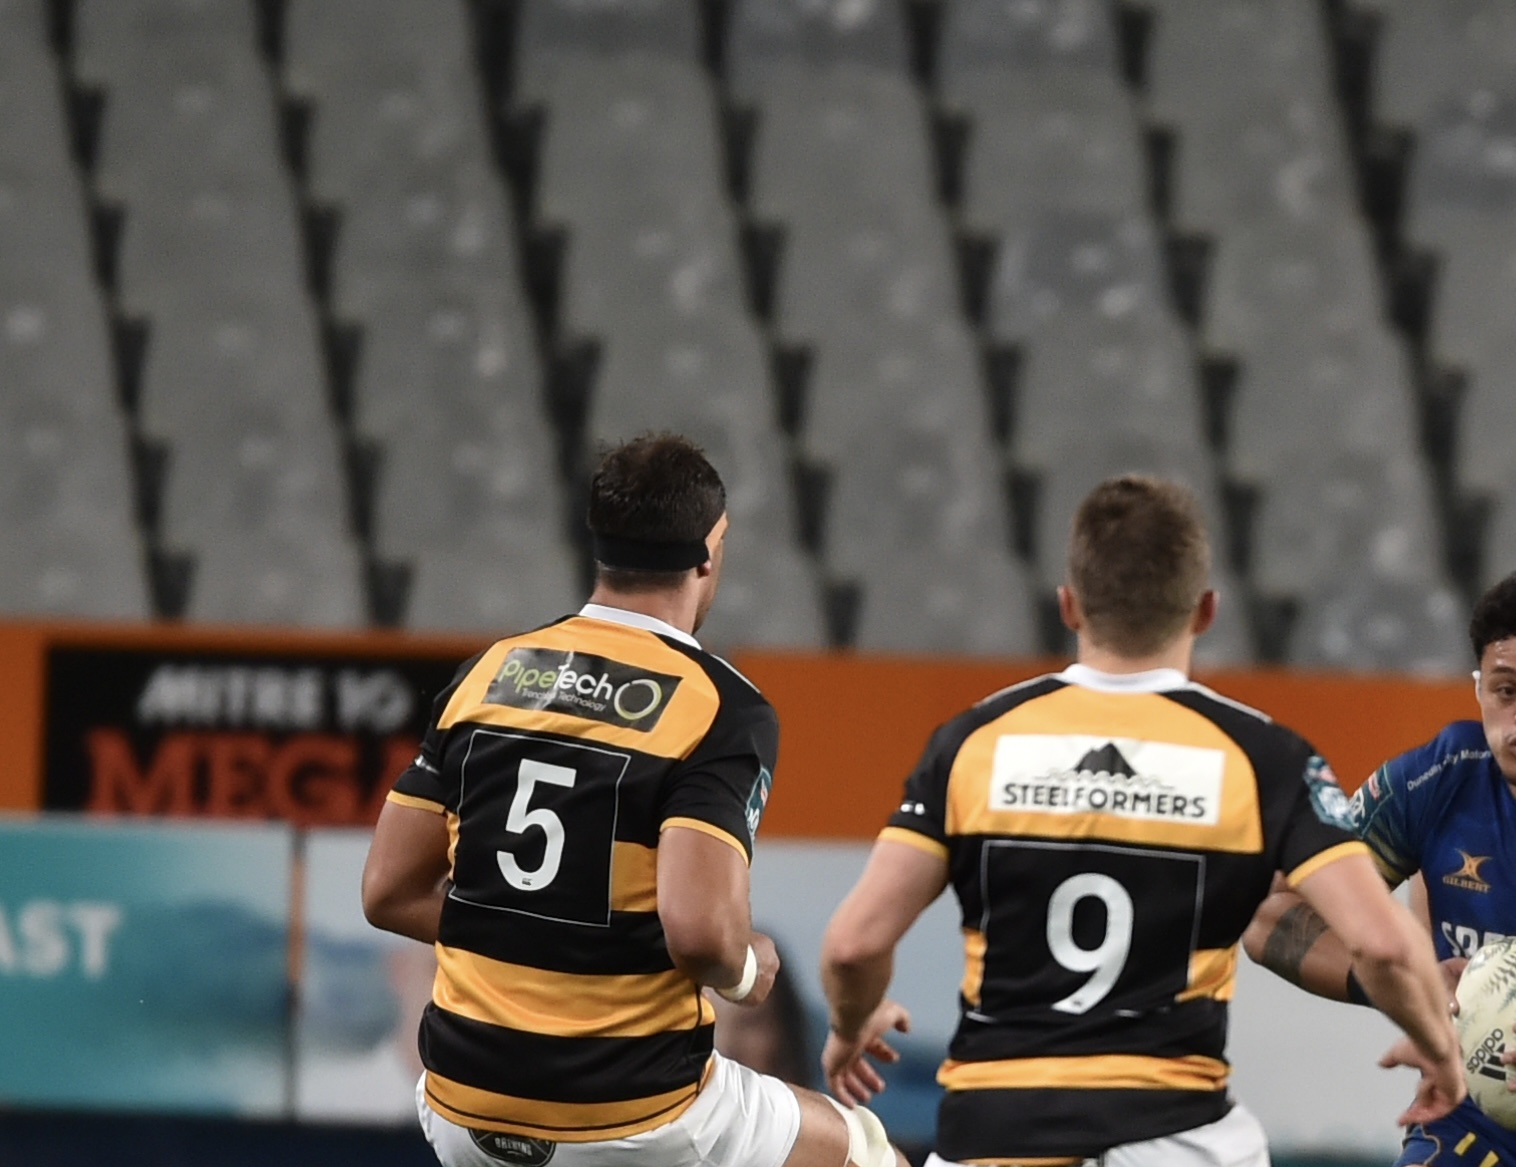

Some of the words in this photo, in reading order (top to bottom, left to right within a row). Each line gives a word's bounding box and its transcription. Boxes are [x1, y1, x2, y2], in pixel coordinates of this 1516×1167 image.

[496, 758, 577, 891] 5
[1442, 874, 1491, 894] GILBERT
[1046, 872, 1133, 1015] 9
[1466, 1027, 1504, 1074] adidas
